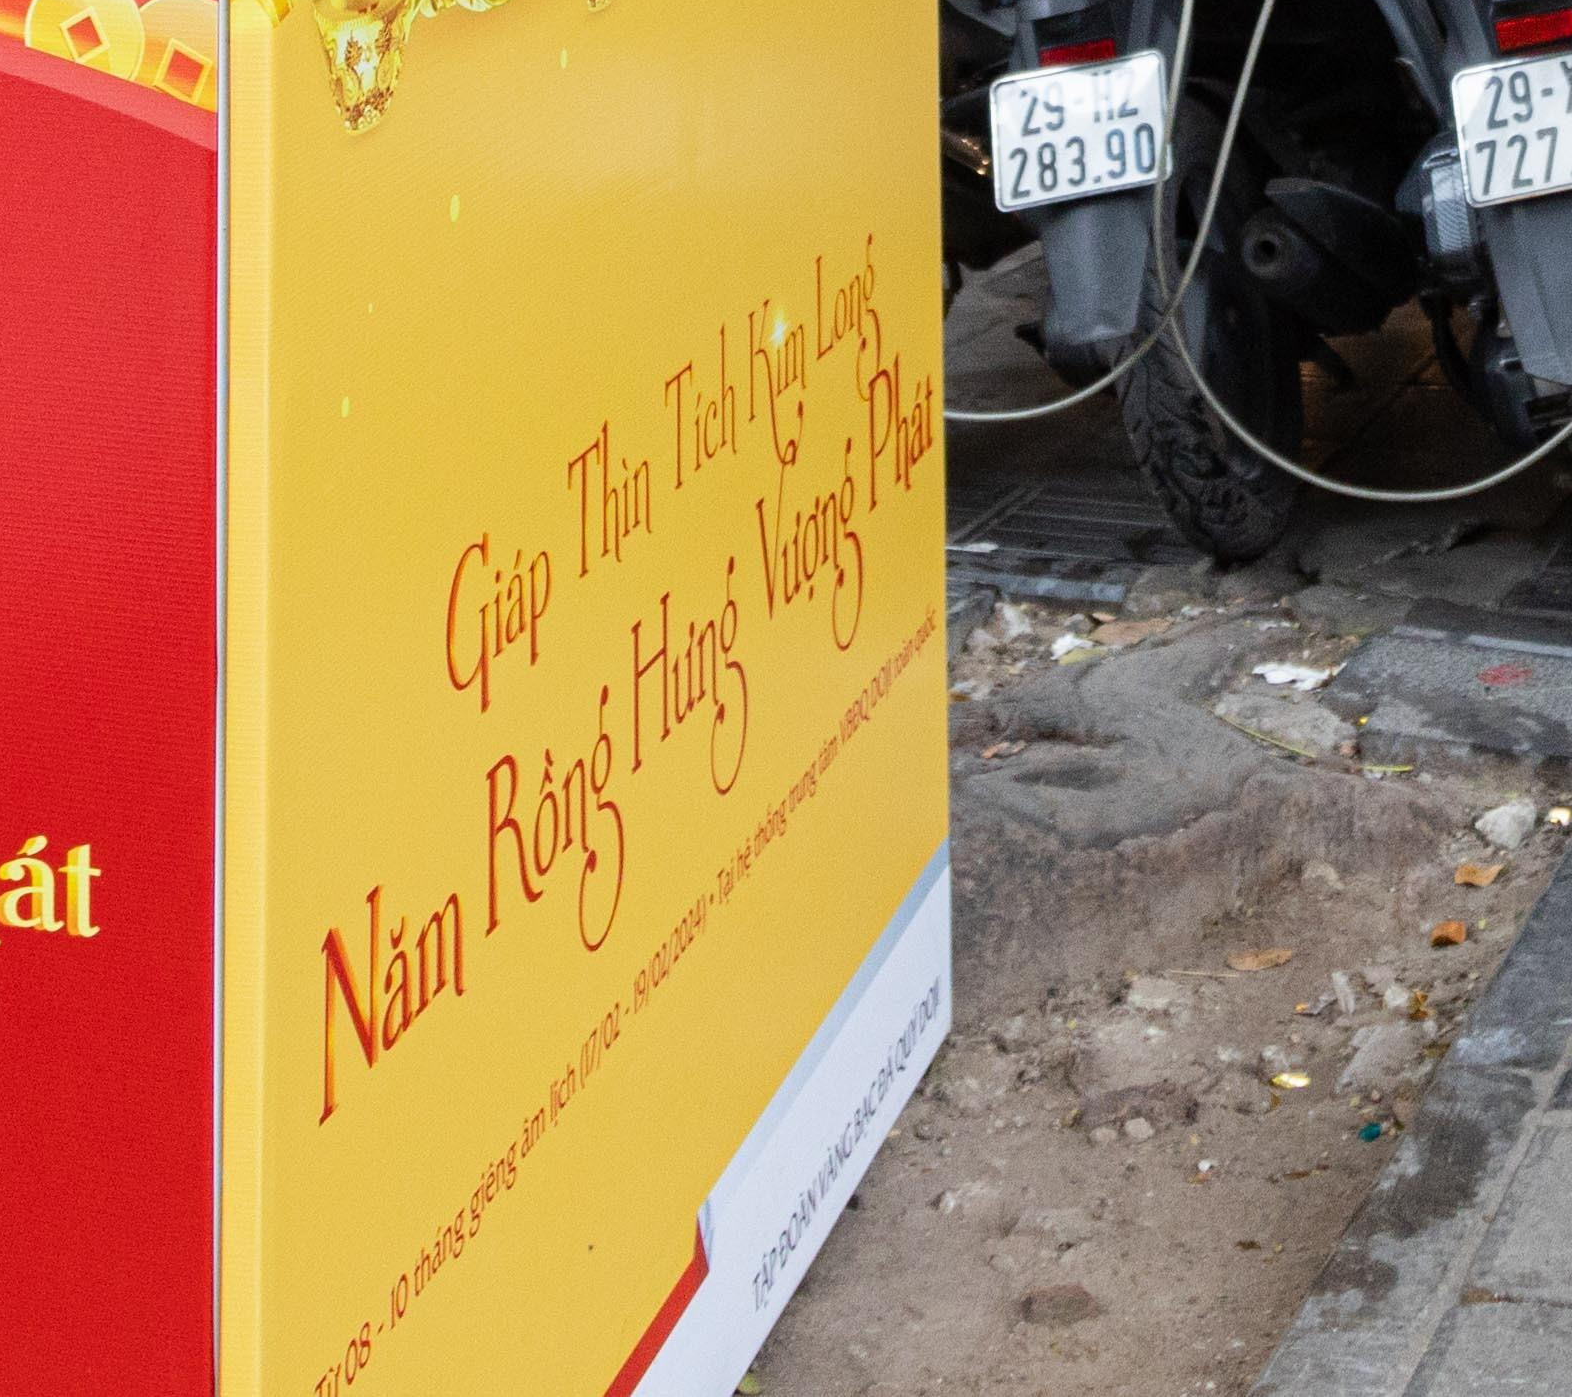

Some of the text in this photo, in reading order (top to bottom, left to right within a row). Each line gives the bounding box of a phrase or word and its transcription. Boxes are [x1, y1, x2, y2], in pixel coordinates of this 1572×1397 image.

[1008, 121, 1158, 202] 283.90
[444, 233, 883, 715] Giáp Thìn Tích Kim Long
[318, 348, 939, 1128] Năm Rồng Hưng Vượng Phát
